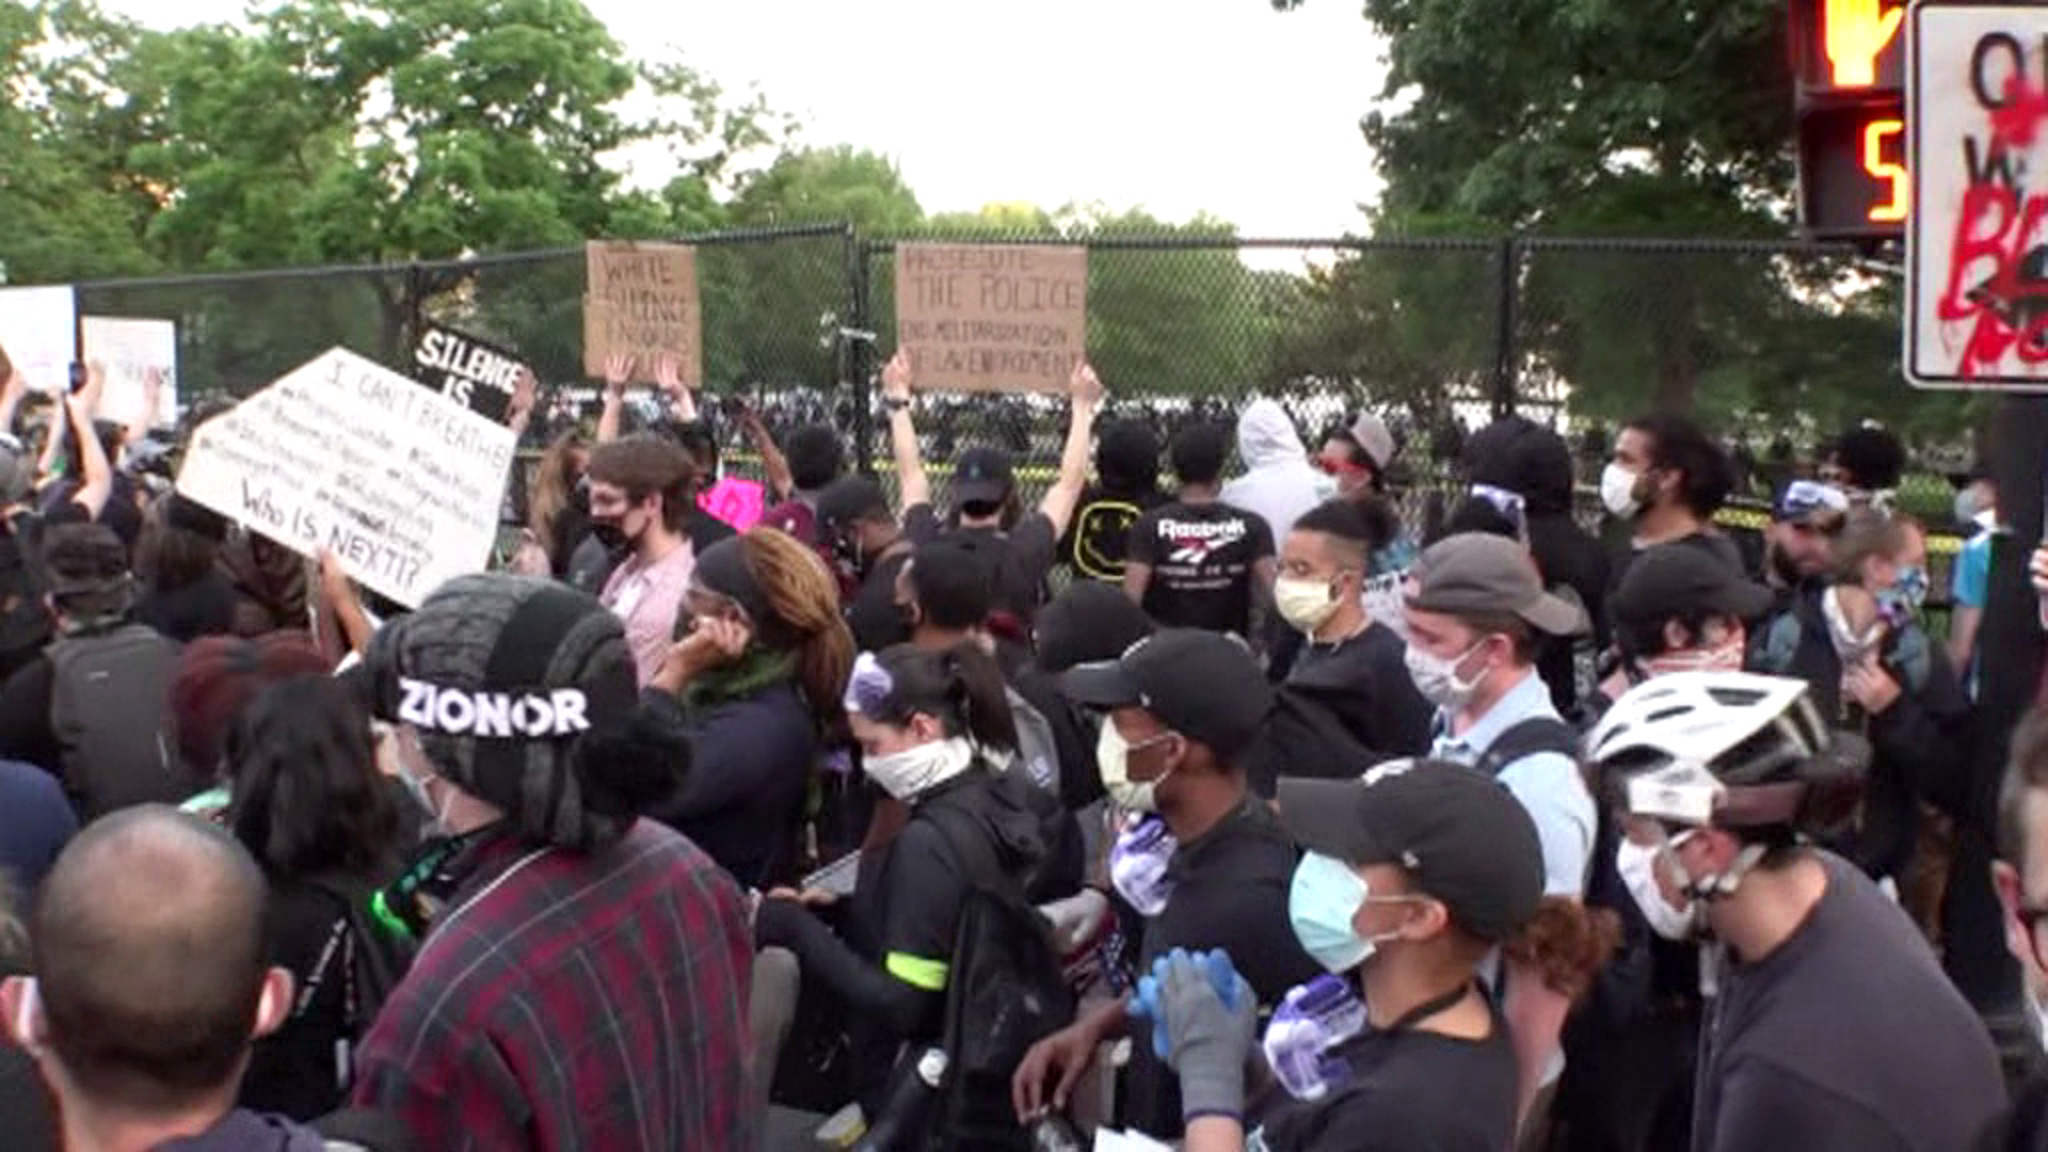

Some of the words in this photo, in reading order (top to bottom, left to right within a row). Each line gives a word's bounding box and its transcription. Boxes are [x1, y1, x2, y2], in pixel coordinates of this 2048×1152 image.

[1864, 120, 1909, 221] 5
[910, 274, 962, 312] THE
[979, 273, 1079, 312] POLICE
[325, 360, 346, 388] I
[416, 328, 522, 396] SILENCE
[292, 507, 318, 541] IS
[398, 676, 592, 738] ZIONOR
